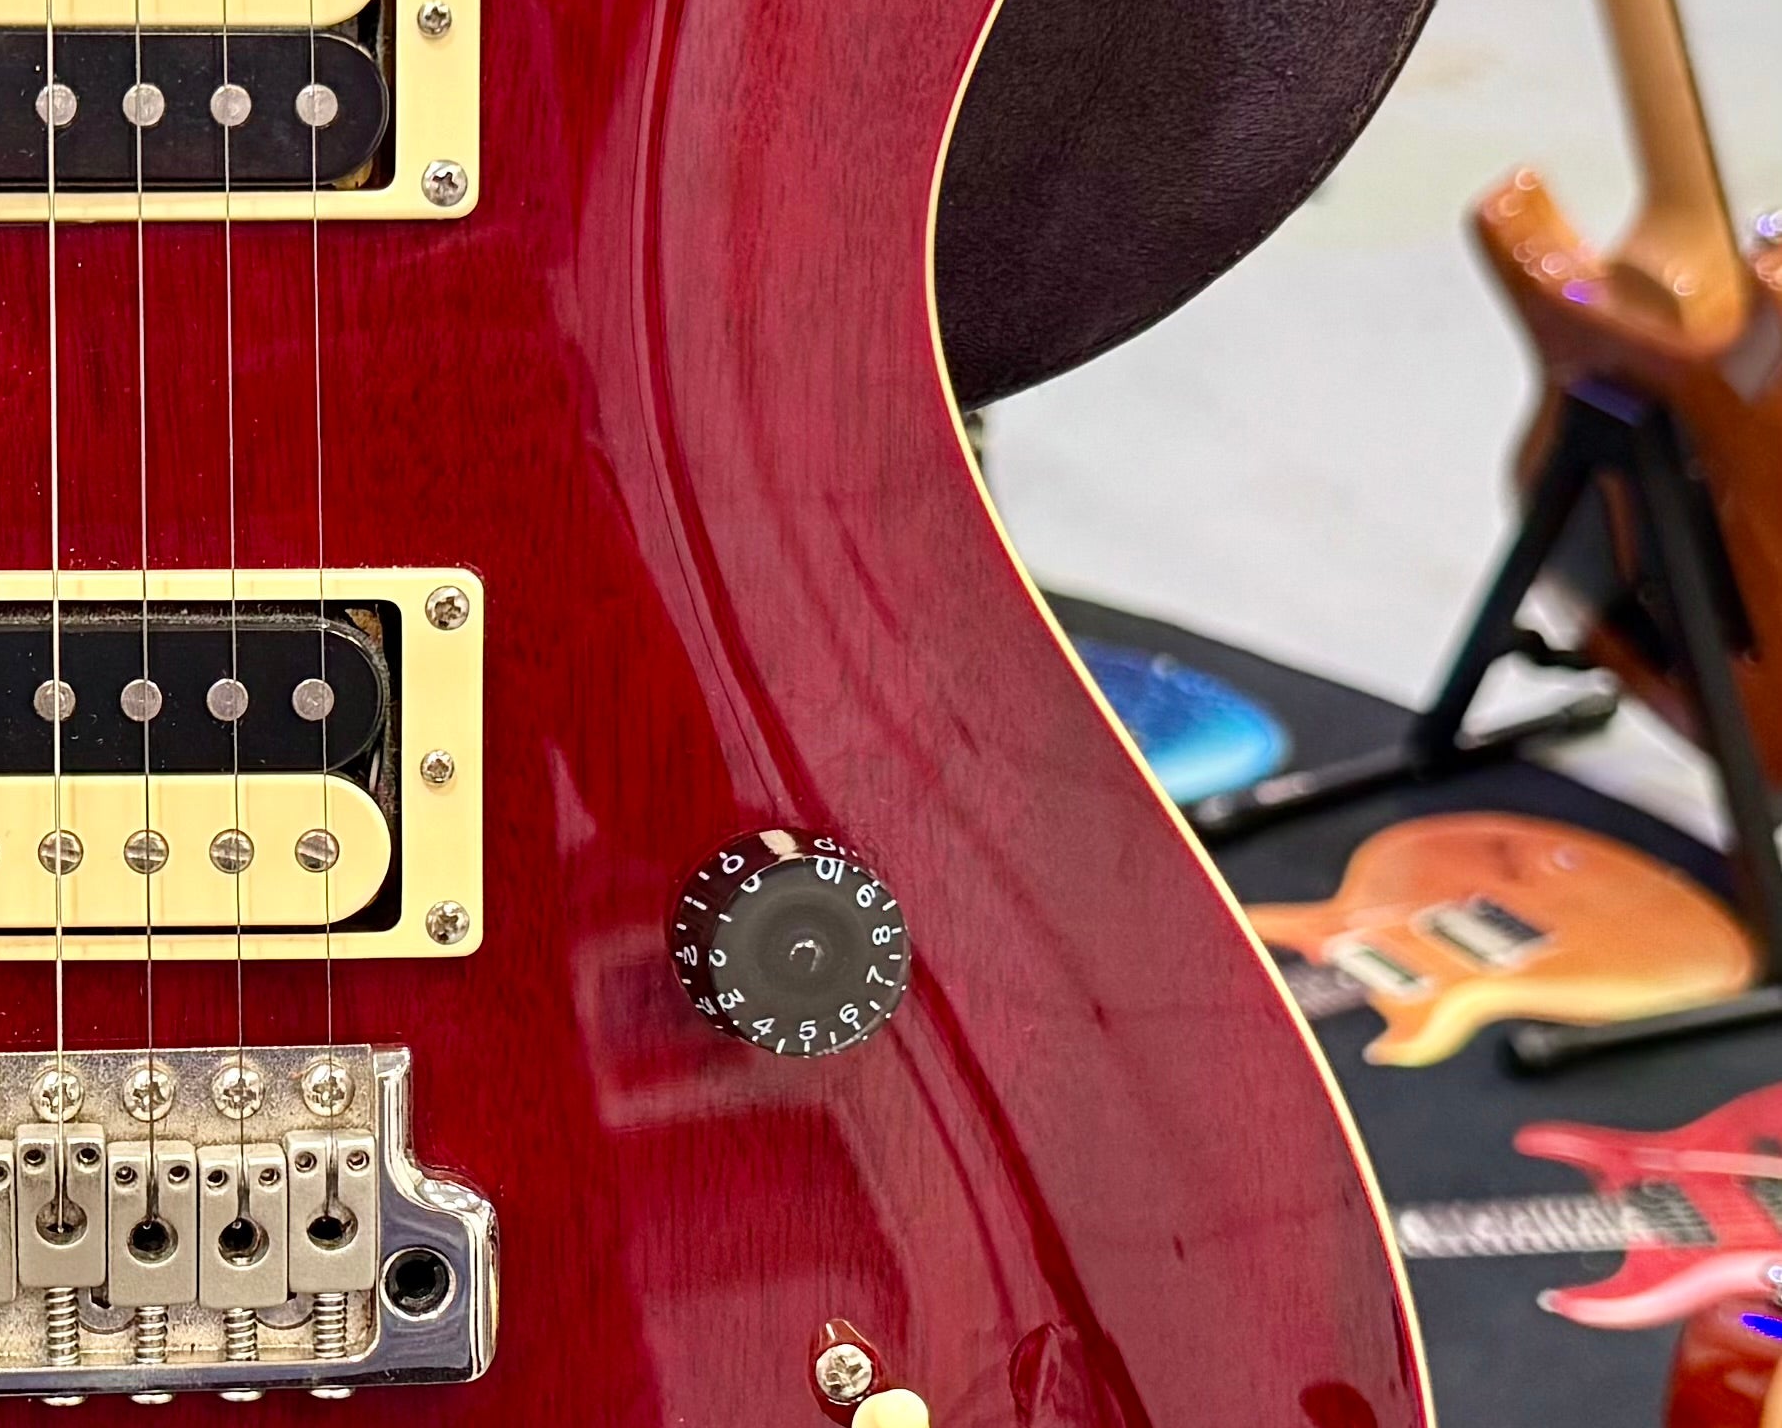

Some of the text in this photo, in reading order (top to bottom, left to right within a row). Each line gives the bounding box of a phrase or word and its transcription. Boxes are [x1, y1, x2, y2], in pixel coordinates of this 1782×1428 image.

[855, 883, 877, 908] 9
[871, 924, 891, 946] 8
[866, 964, 885, 984] 7
[838, 1003, 859, 1023] 6
[751, 1017, 775, 1036] 4
[798, 1019, 817, 1041] 5
